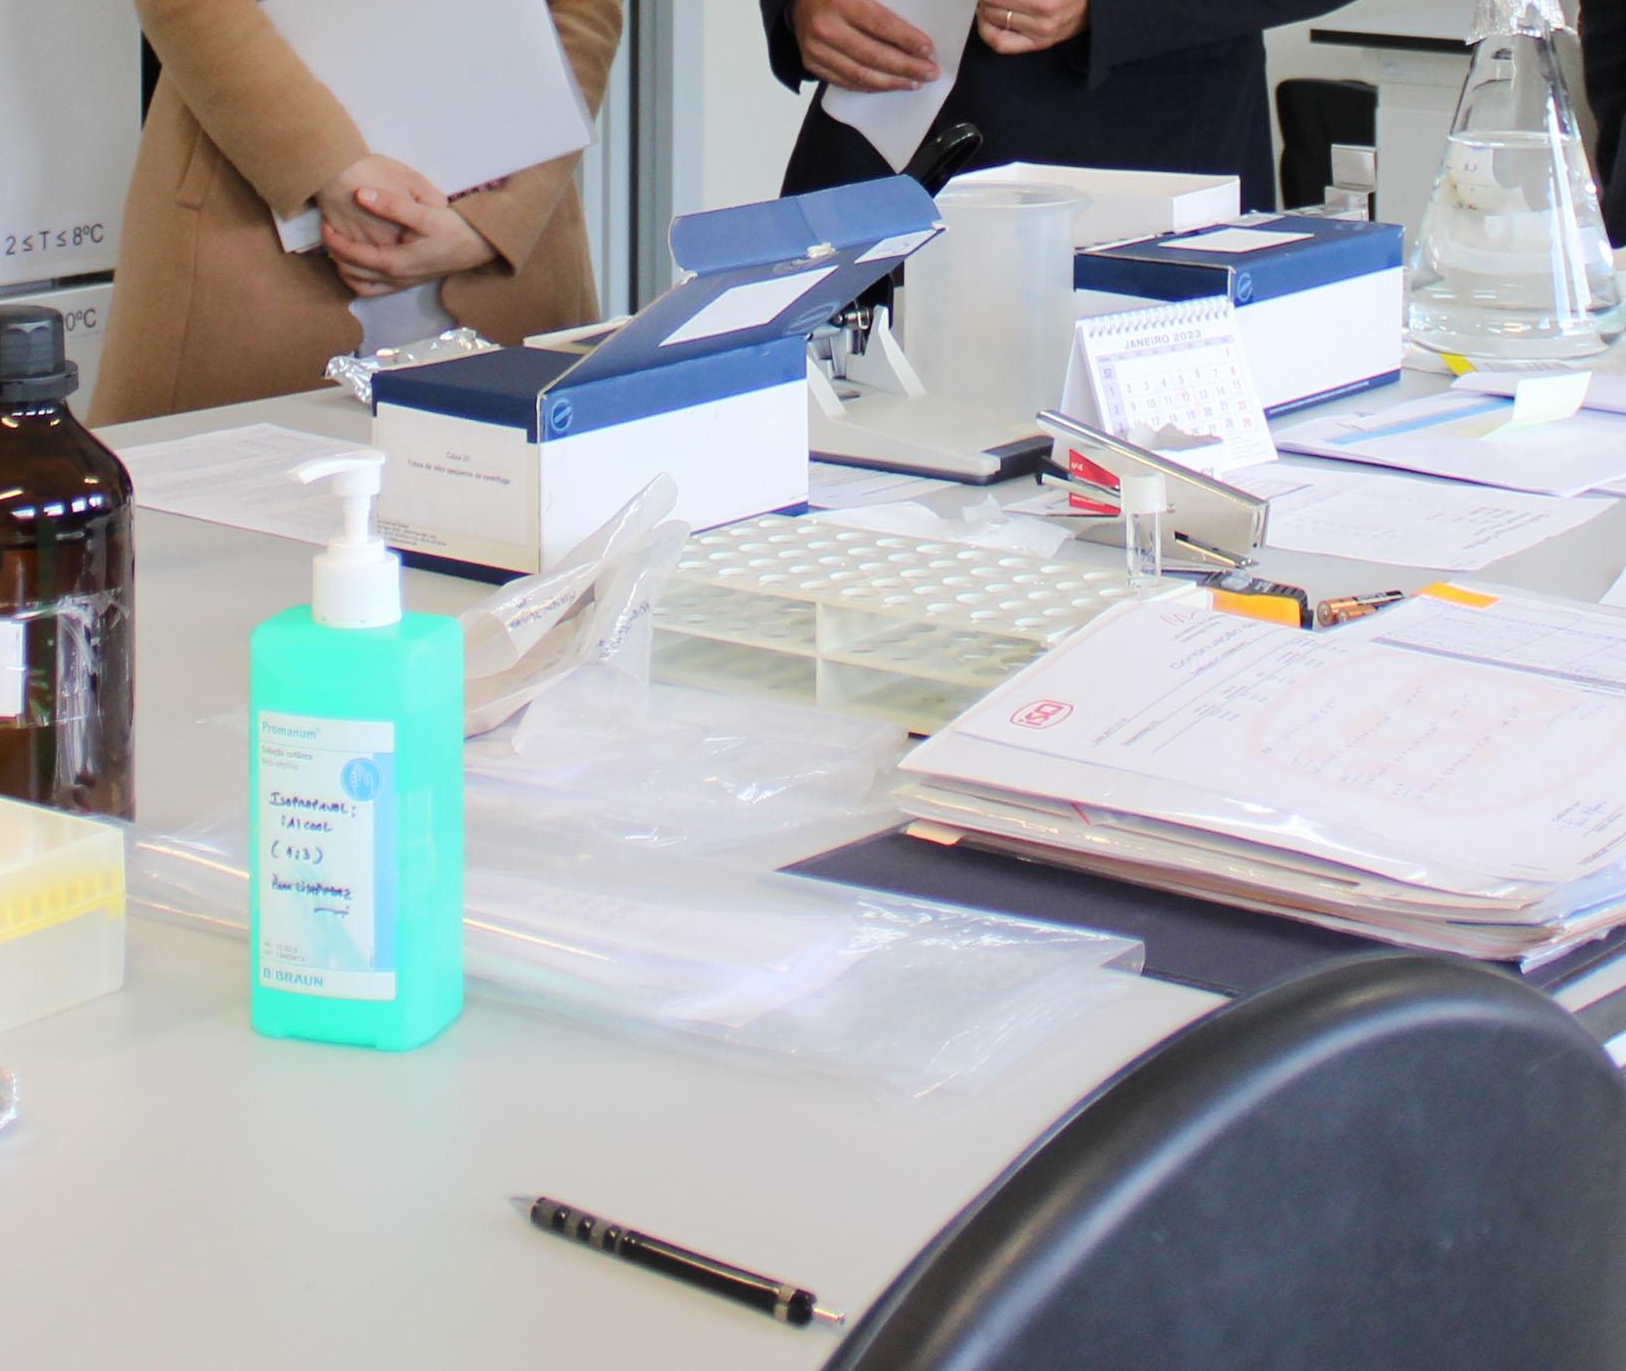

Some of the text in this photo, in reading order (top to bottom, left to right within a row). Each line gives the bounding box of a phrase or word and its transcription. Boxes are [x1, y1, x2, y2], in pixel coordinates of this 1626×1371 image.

[1124, 330, 1203, 350] JANEIRO 2023
[275, 970, 324, 988] BRAUN
